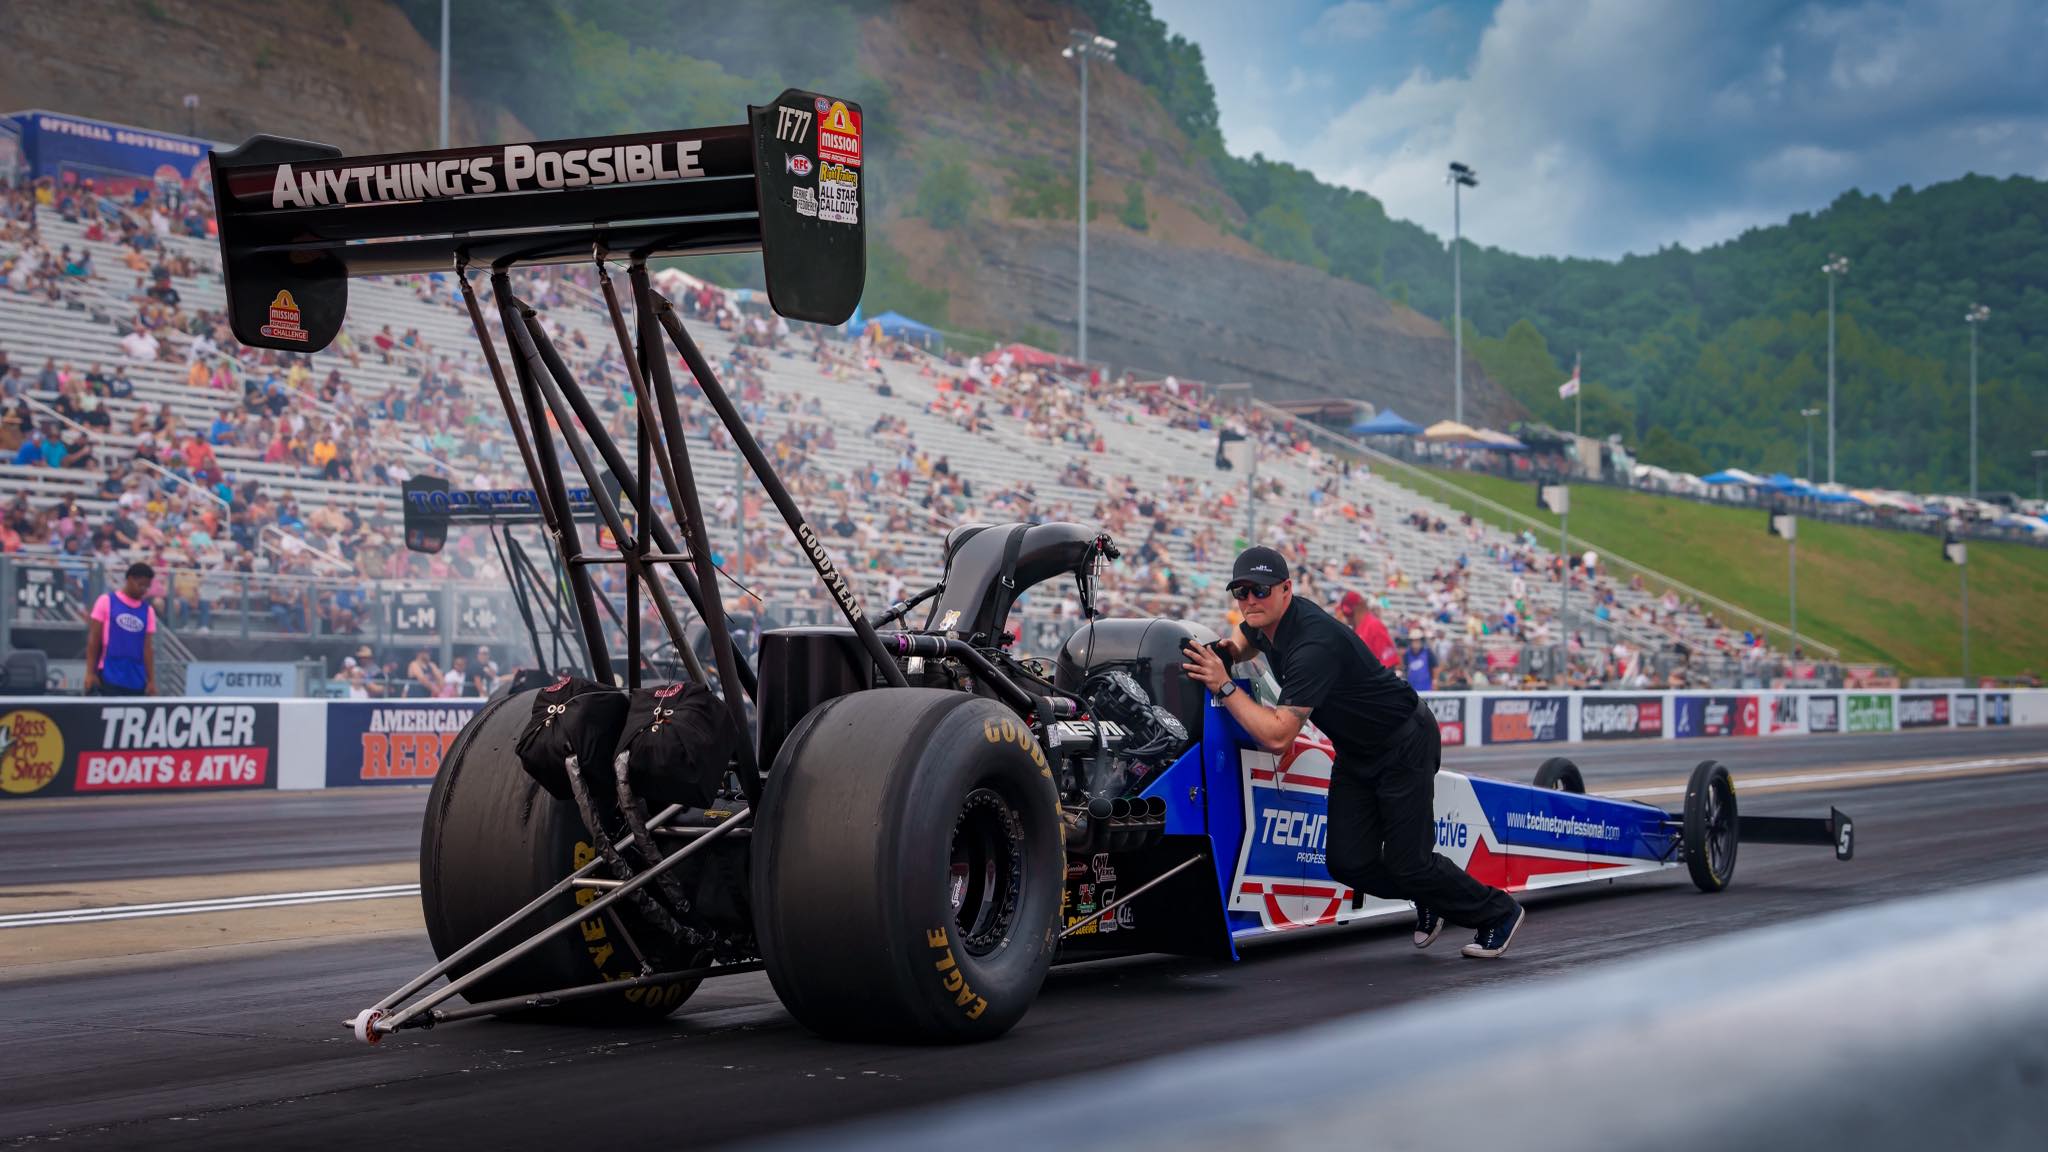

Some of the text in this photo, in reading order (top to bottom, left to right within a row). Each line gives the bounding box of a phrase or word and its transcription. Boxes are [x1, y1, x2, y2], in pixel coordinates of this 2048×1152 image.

[776, 105, 813, 144] TF77
[821, 132, 858, 153] MISSION
[272, 140, 705, 209] ANYTHING'S POSSIBLE
[820, 185, 856, 202] ALL STAR
[820, 199, 856, 214] CALLOUT
[271, 308, 299, 322] MISSION
[273, 328, 307, 340] CHALLENGE
[798, 523, 862, 622] GOODYEAR
[226, 672, 282, 688] GETTRX
[12, 714, 47, 738] Bass
[101, 705, 257, 749] TRACKER
[369, 708, 474, 732] AMERICAN
[12, 738, 39, 760] Pro
[11, 760, 54, 785] Shops
[86, 754, 257, 785] BOATS & ATVs
[1507, 810, 1621, 840] www.technetprofessional.com
[1838, 823, 1852, 854] 5
[926, 925, 989, 1021] EAGLE
